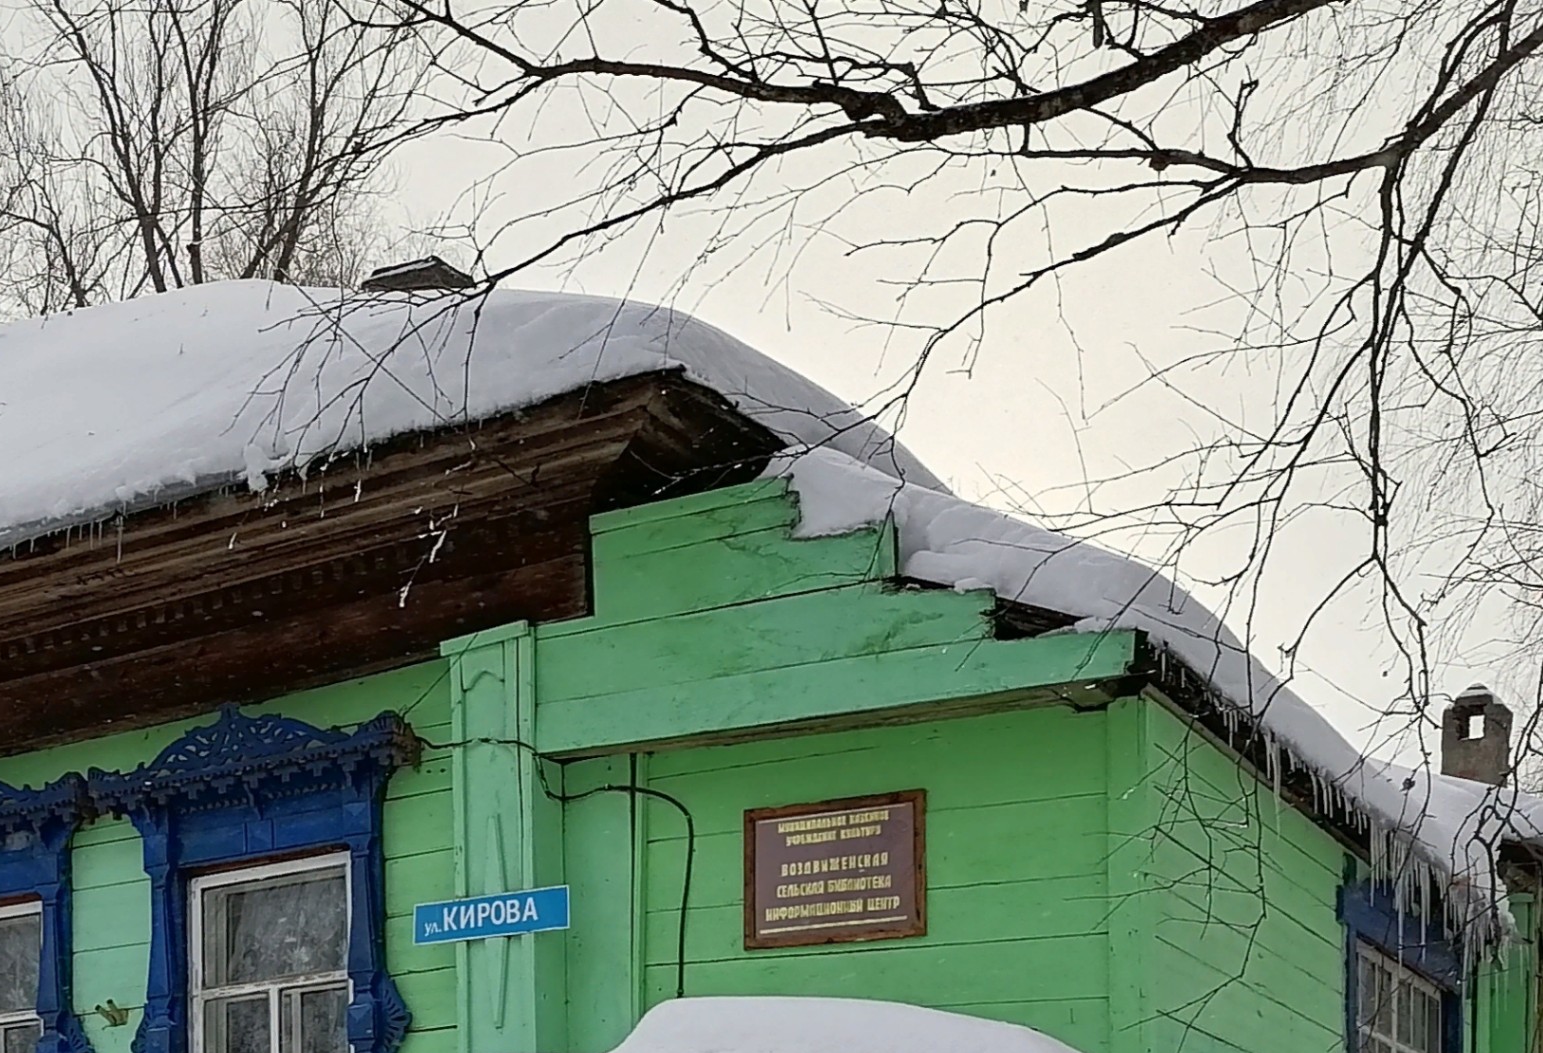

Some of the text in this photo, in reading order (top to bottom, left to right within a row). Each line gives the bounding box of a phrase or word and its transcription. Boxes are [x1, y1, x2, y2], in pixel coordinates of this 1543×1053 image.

[781, 852, 889, 877] ВОЗДВИЖЕНСКАЯ
[776, 875, 892, 899] СЕЛЬСКАЯ БИБЛИОТЕКА
[867, 896, 900, 911] ЦЕНТР
